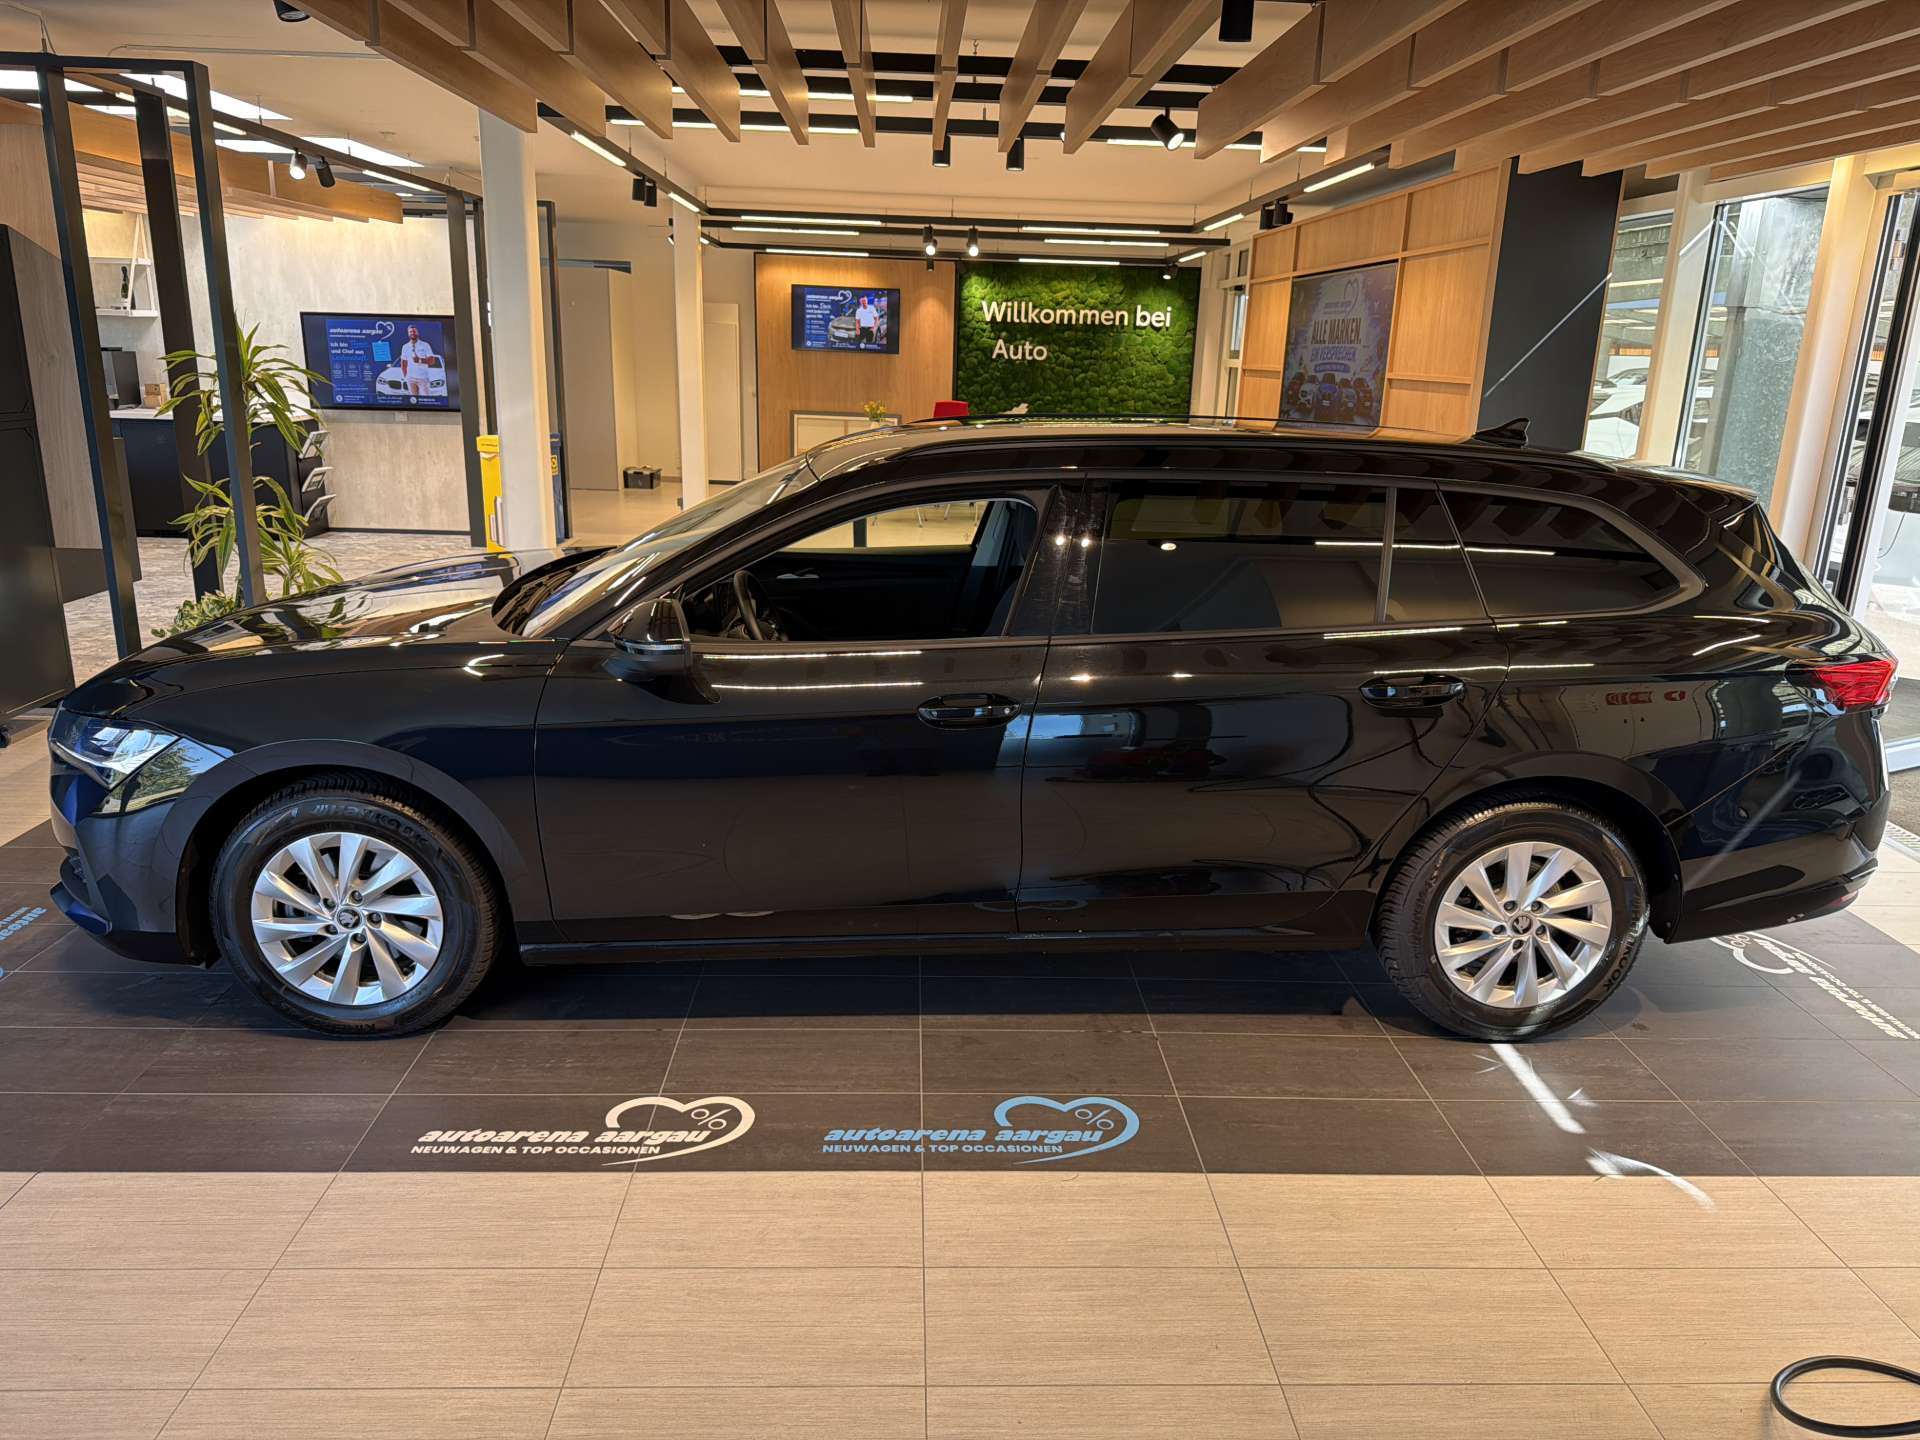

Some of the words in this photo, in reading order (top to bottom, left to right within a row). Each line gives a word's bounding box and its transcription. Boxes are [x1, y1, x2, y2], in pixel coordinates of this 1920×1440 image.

[981, 300, 1129, 327] Willkommen
[1135, 305, 1172, 327] bei
[1311, 319, 1328, 345] ALLE
[992, 338, 1048, 361] Auto
[418, 1128, 590, 1143] autoarena
[595, 1130, 712, 1146] aargau
[823, 1127, 987, 1142] autoarena
[994, 1129, 1104, 1144] aargau
[410, 1145, 503, 1155] NEUWAGEN
[505, 1145, 518, 1155] &
[521, 1146, 555, 1155] TOP
[555, 1146, 661, 1155] OCCASIONEN
[822, 1144, 912, 1154] NEUWAGEN
[914, 1144, 926, 1153] &
[929, 1144, 959, 1153] TOP
[961, 1144, 1063, 1154] OCCASIONEN
